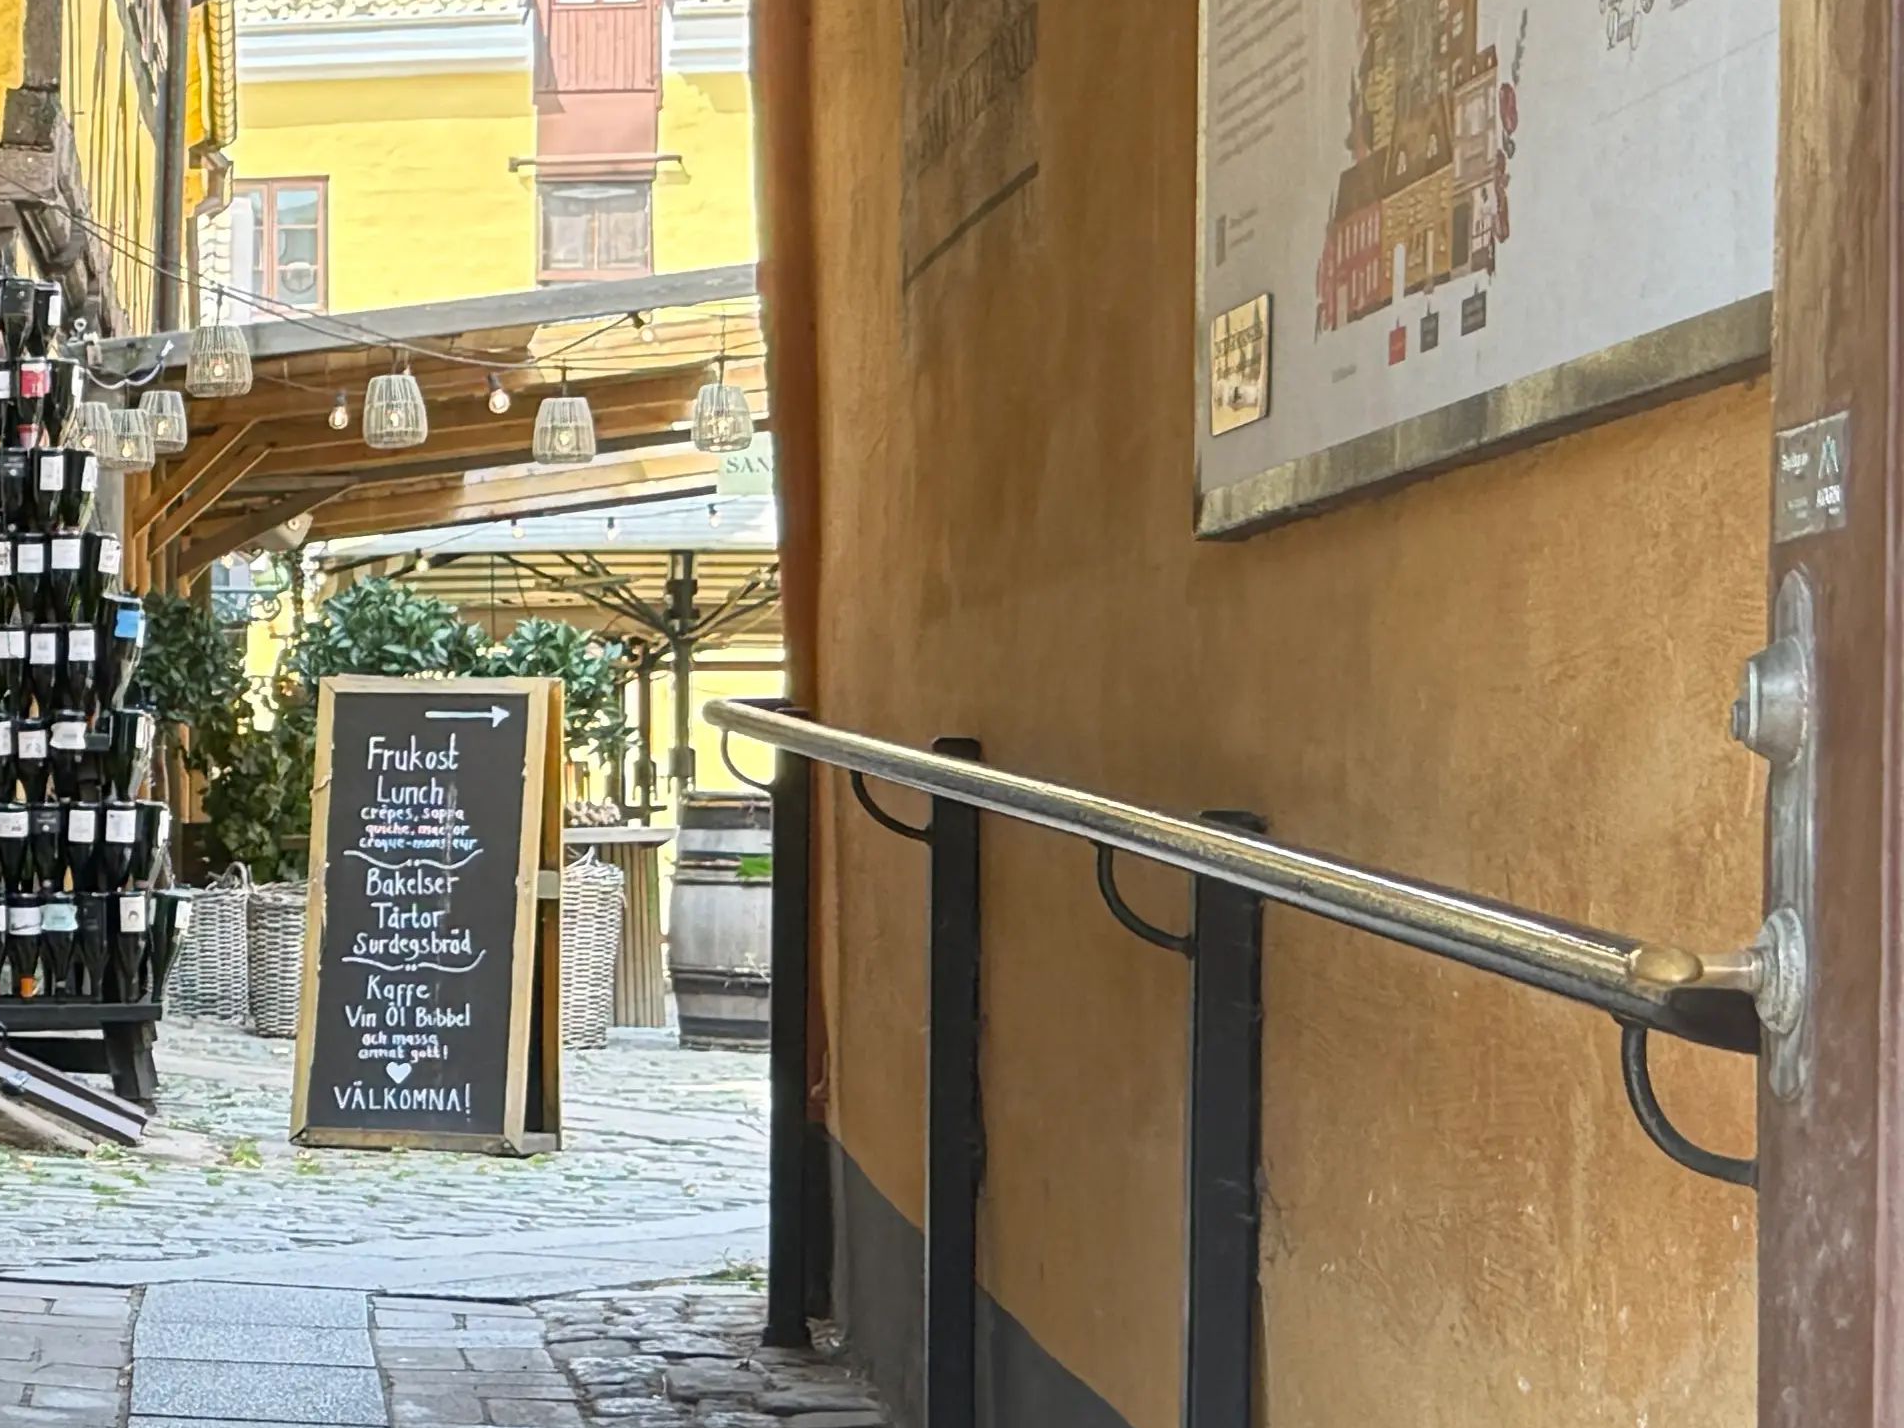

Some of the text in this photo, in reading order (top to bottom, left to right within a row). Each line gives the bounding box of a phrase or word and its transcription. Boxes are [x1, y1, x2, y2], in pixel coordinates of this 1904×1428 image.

[367, 733, 460, 771] Frukost
[377, 775, 444, 805] Lunch
[359, 837, 478, 853] croque-monseur
[366, 867, 460, 896] Bakelser
[370, 902, 446, 929] Tårtor
[353, 928, 472, 961] Surdegsbröd
[366, 974, 431, 1007] Kaffe
[345, 1001, 471, 1028] Vin Öl Bubbel
[358, 1047, 405, 1059] annat
[392, 1033, 439, 1047] massa
[334, 1080, 471, 1115] VÄLKOMNA!
